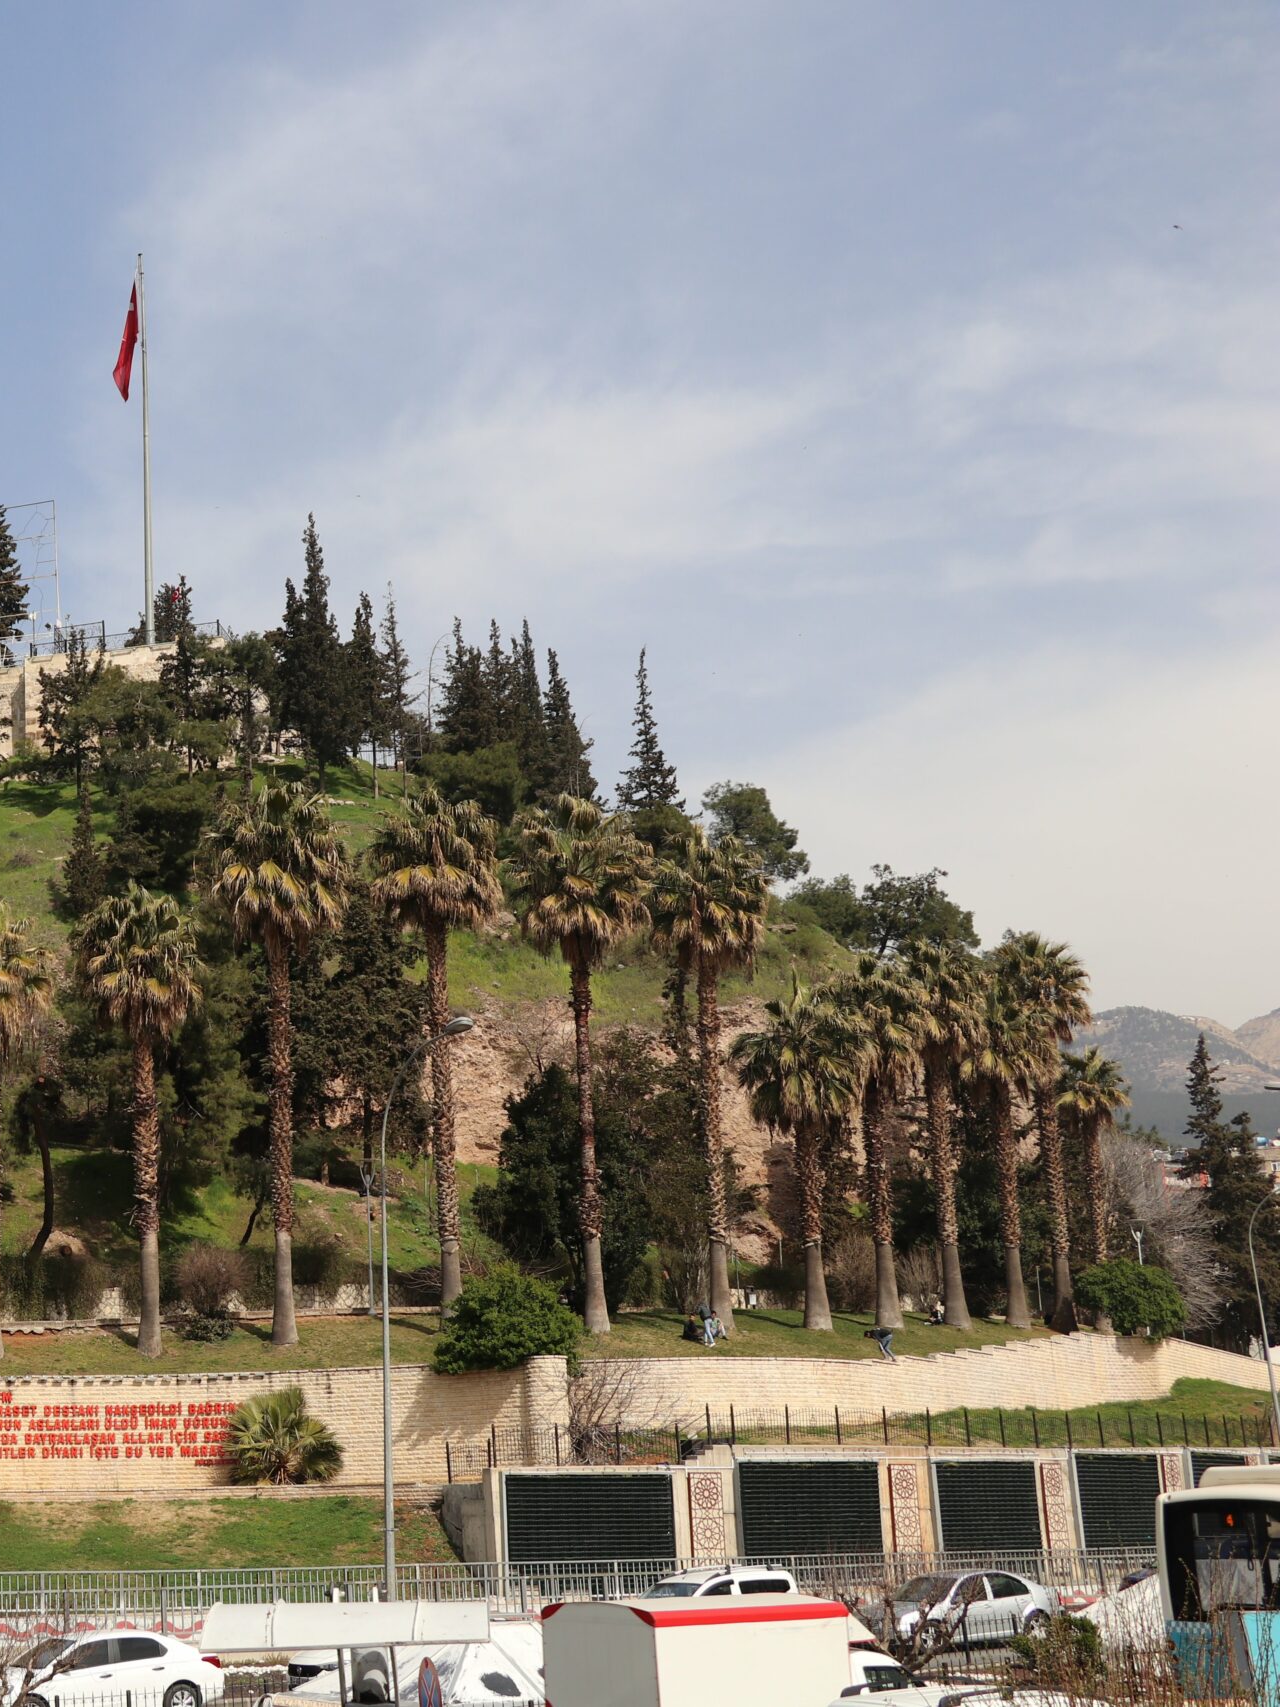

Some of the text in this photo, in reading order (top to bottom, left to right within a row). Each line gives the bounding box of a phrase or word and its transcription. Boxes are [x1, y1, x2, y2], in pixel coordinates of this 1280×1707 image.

[43, 1405, 100, 1418] DESTANI
[188, 1400, 243, 1416] BAĞRIN
[29, 1419, 100, 1431] ASLANLARI
[145, 1416, 177, 1430] İMAN
[24, 1433, 116, 1447] BAYRAKLAŞAN
[123, 1432, 164, 1444] ALLAH
[170, 1430, 198, 1446] İÇİN
[42, 1444, 83, 1459] DİYARI
[125, 1446, 143, 1458] BU
[149, 1446, 174, 1458] YER
